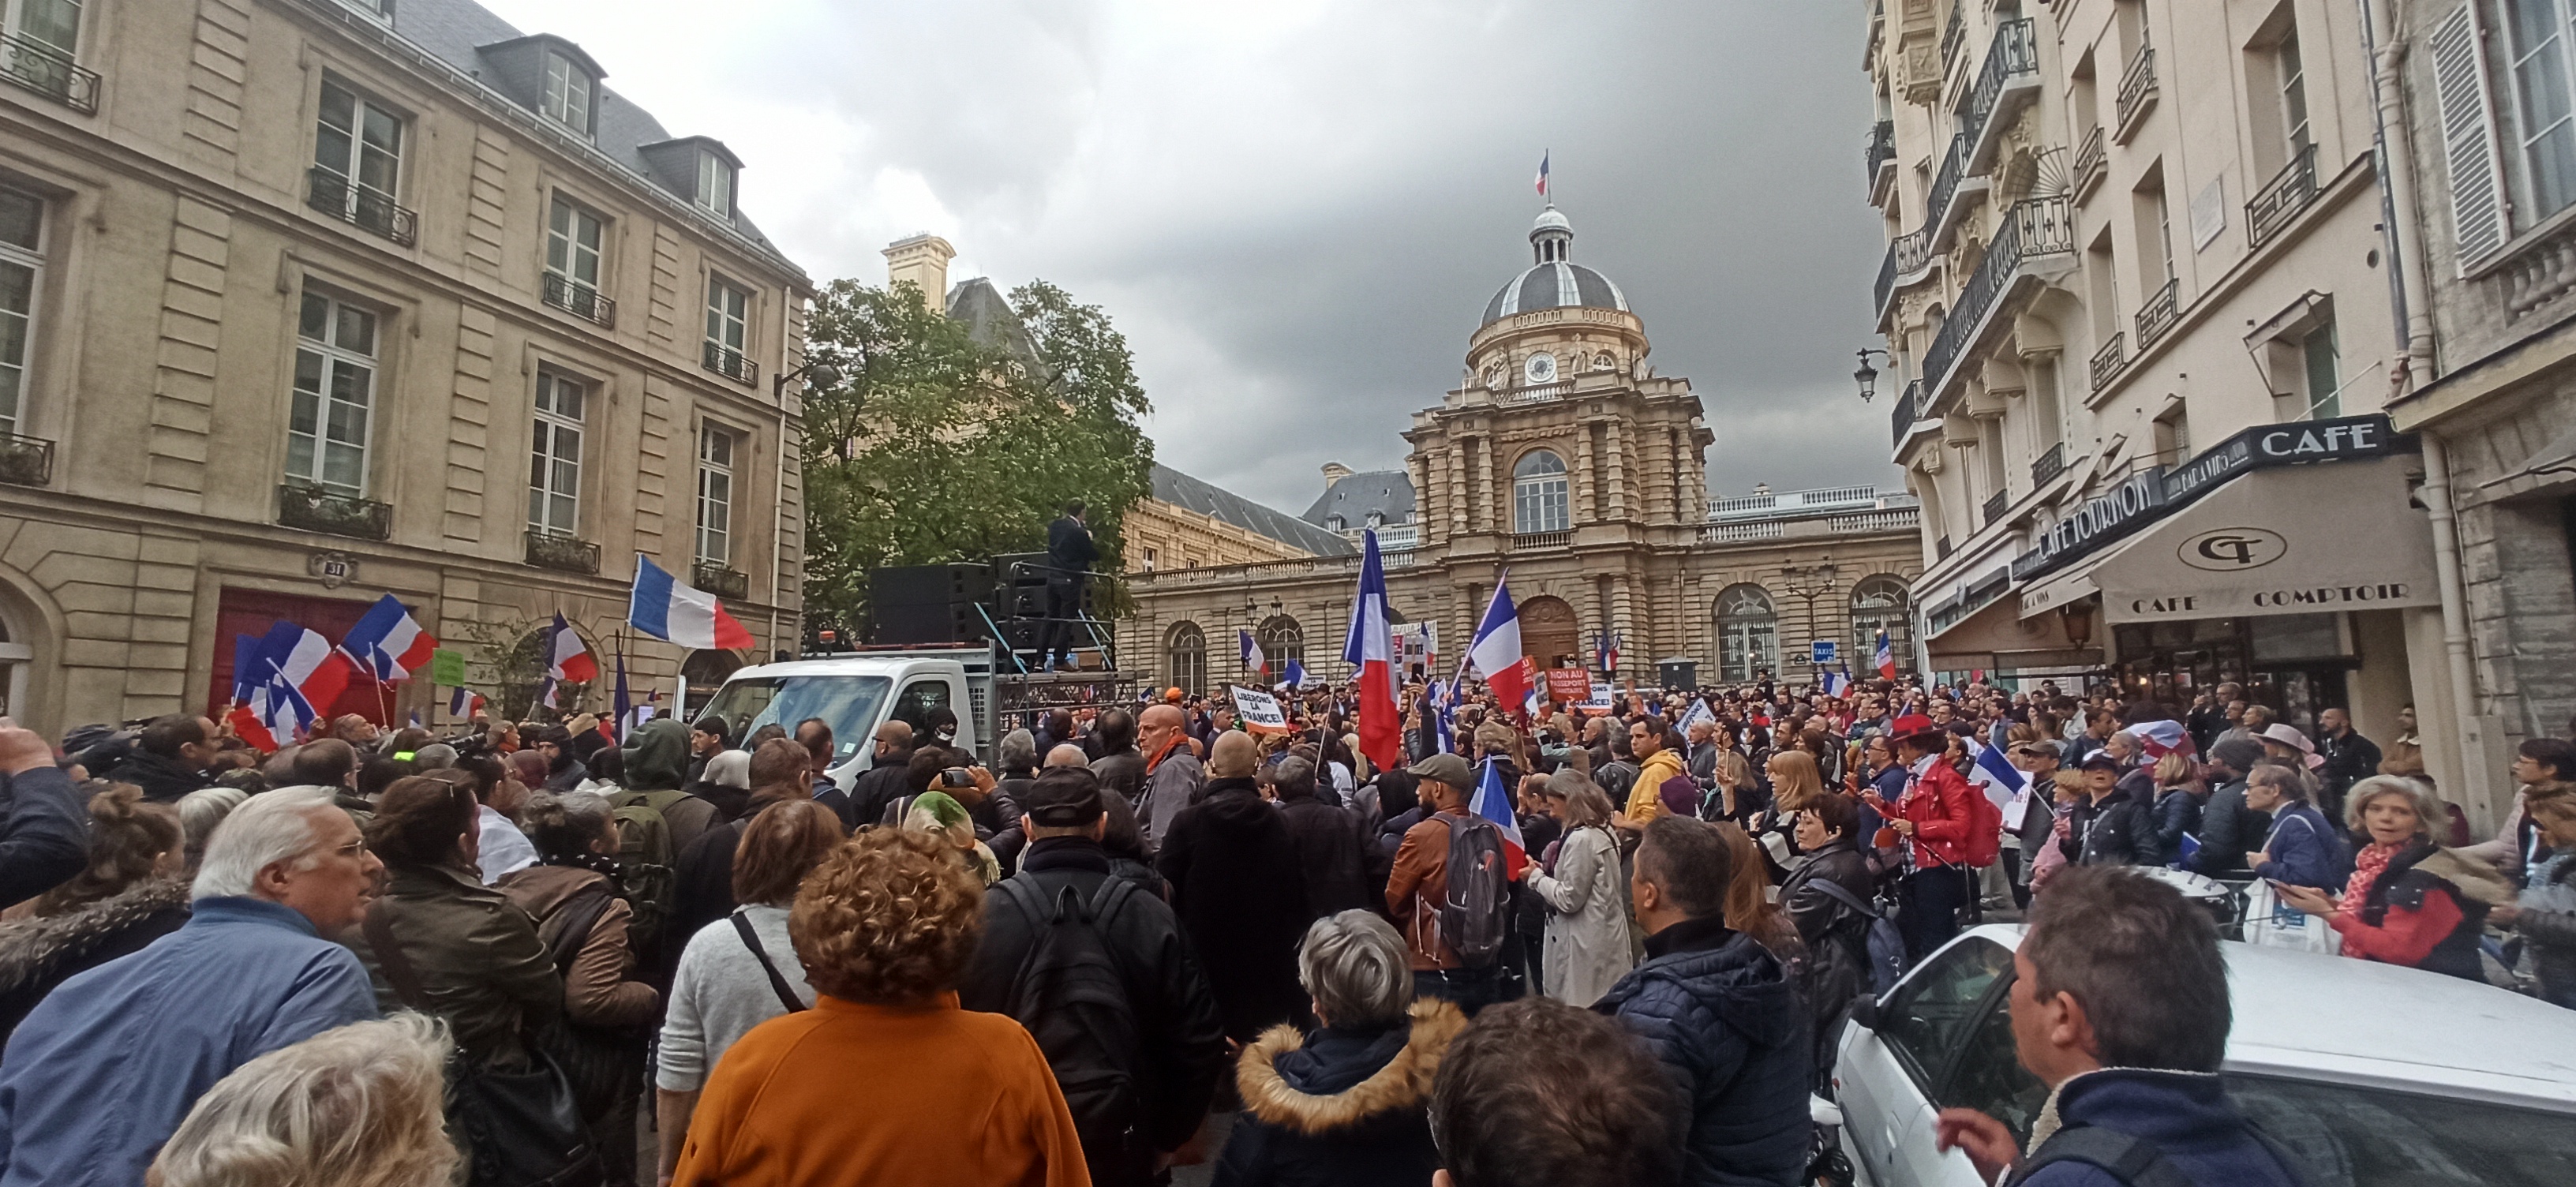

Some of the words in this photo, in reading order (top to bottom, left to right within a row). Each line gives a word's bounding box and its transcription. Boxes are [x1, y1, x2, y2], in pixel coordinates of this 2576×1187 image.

[2261, 423, 2377, 456] CAFE
[2039, 519, 2070, 560] CAFE
[2072, 474, 2151, 544] TOURNON
[328, 564, 342, 575] 31
[2132, 596, 2200, 614] CAFE
[2253, 582, 2410, 608] COMPTOIR
[1571, 670, 1583, 679] AU
[1250, 702, 1261, 711] LA
[1241, 710, 1282, 723] FRANCE!
